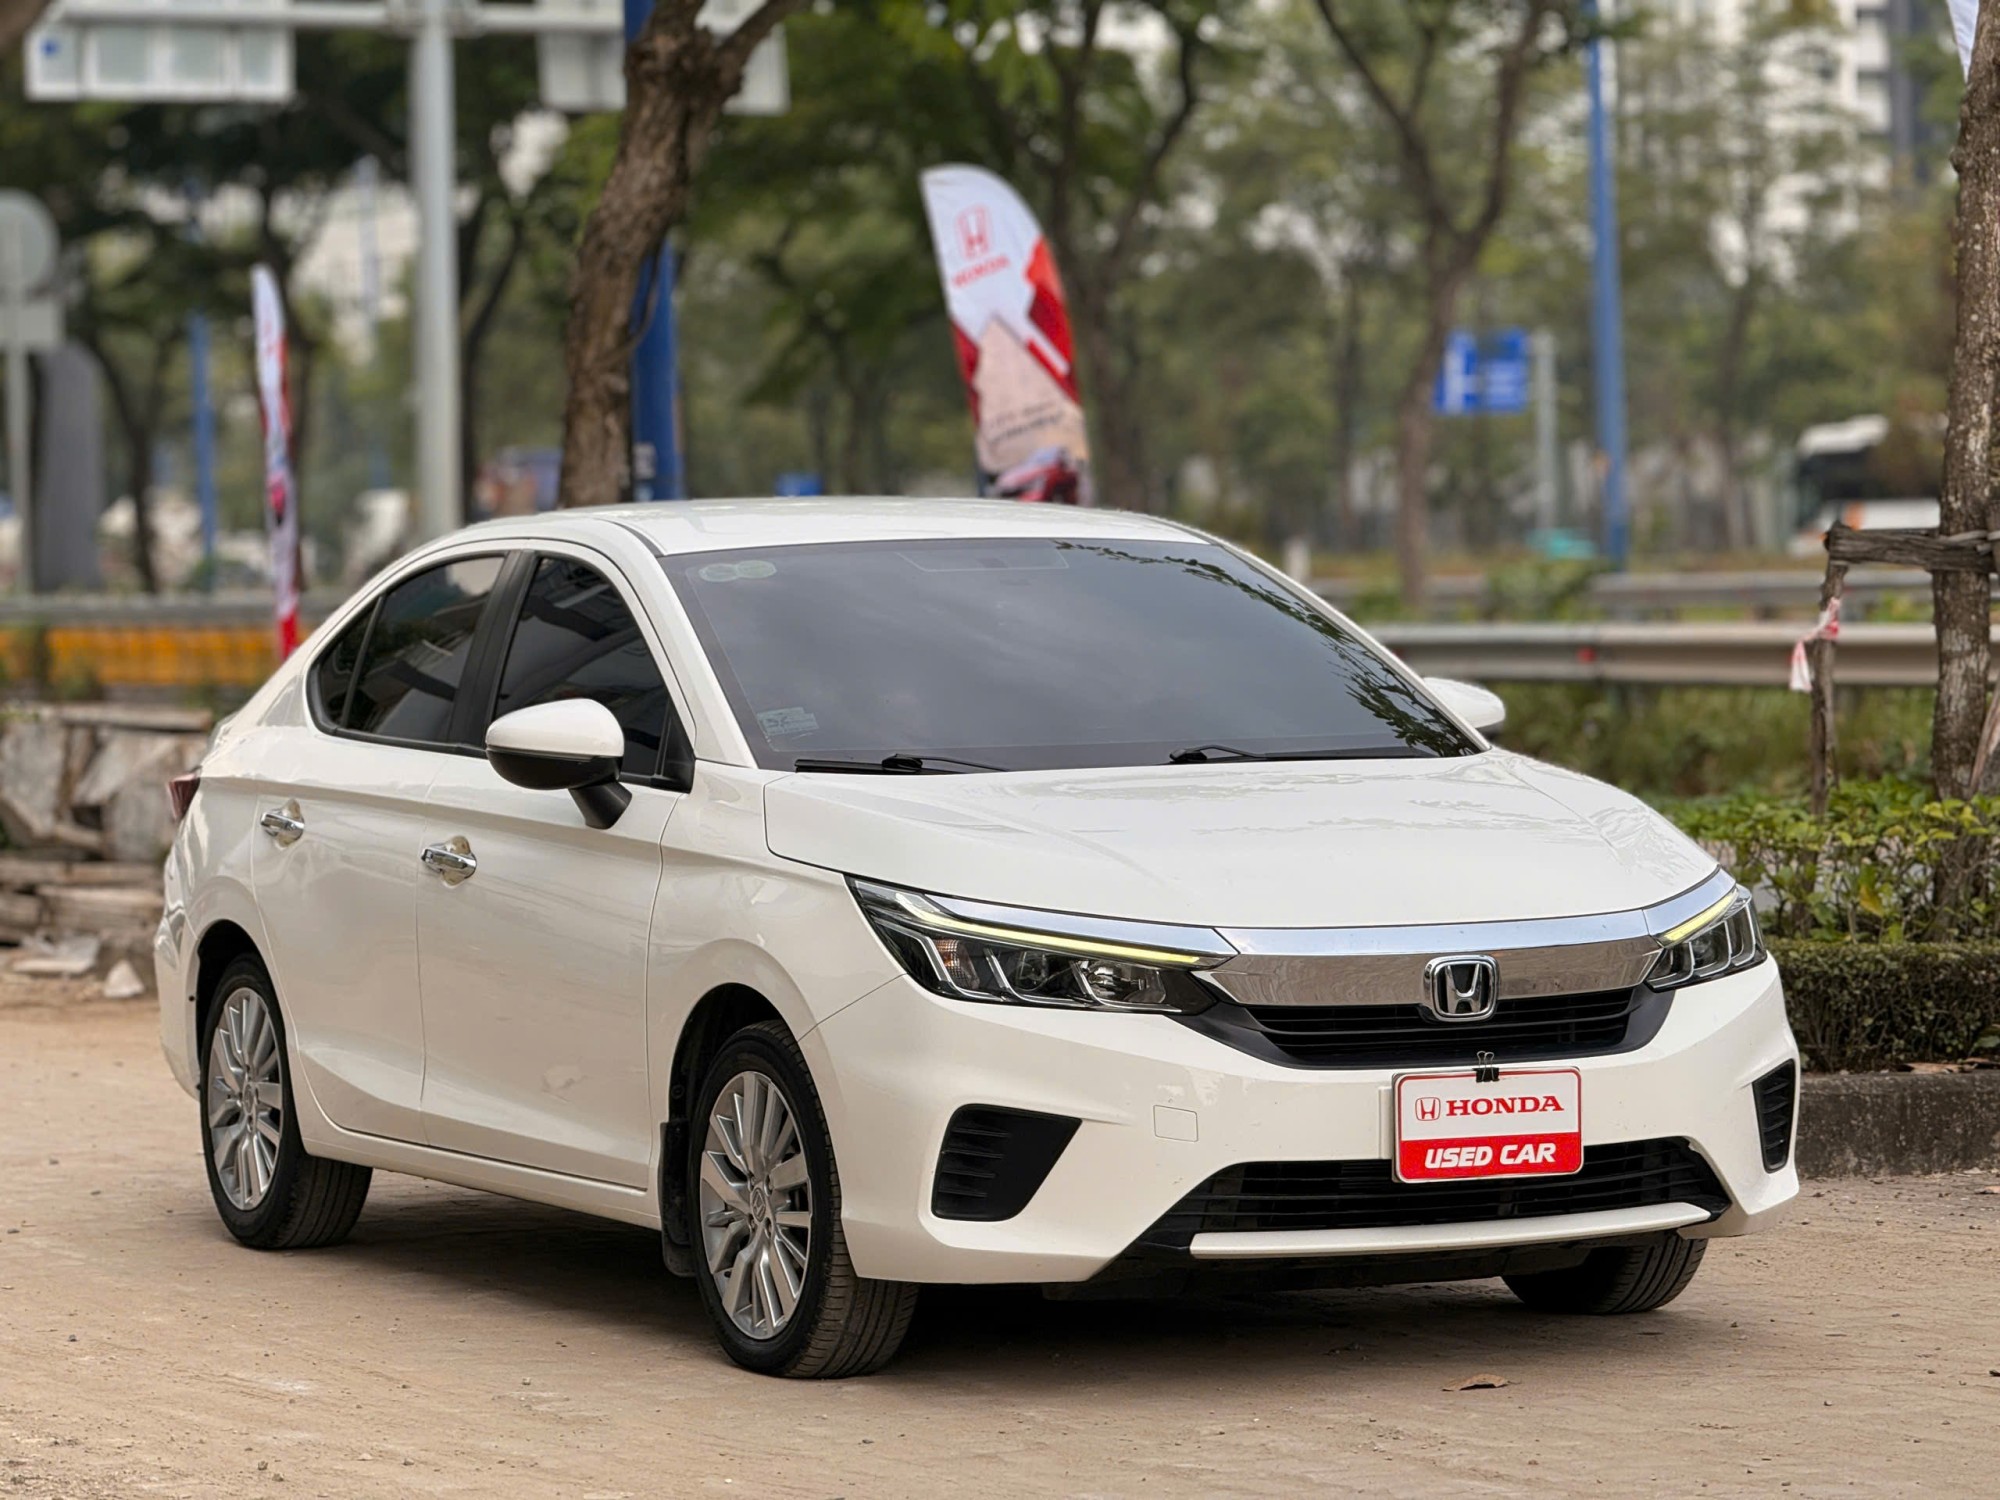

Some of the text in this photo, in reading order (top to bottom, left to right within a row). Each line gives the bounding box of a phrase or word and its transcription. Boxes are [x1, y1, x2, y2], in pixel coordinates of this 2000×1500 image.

[1446, 1095, 1564, 1117] HONDA
[1424, 1142, 1556, 1169] USED CAR
